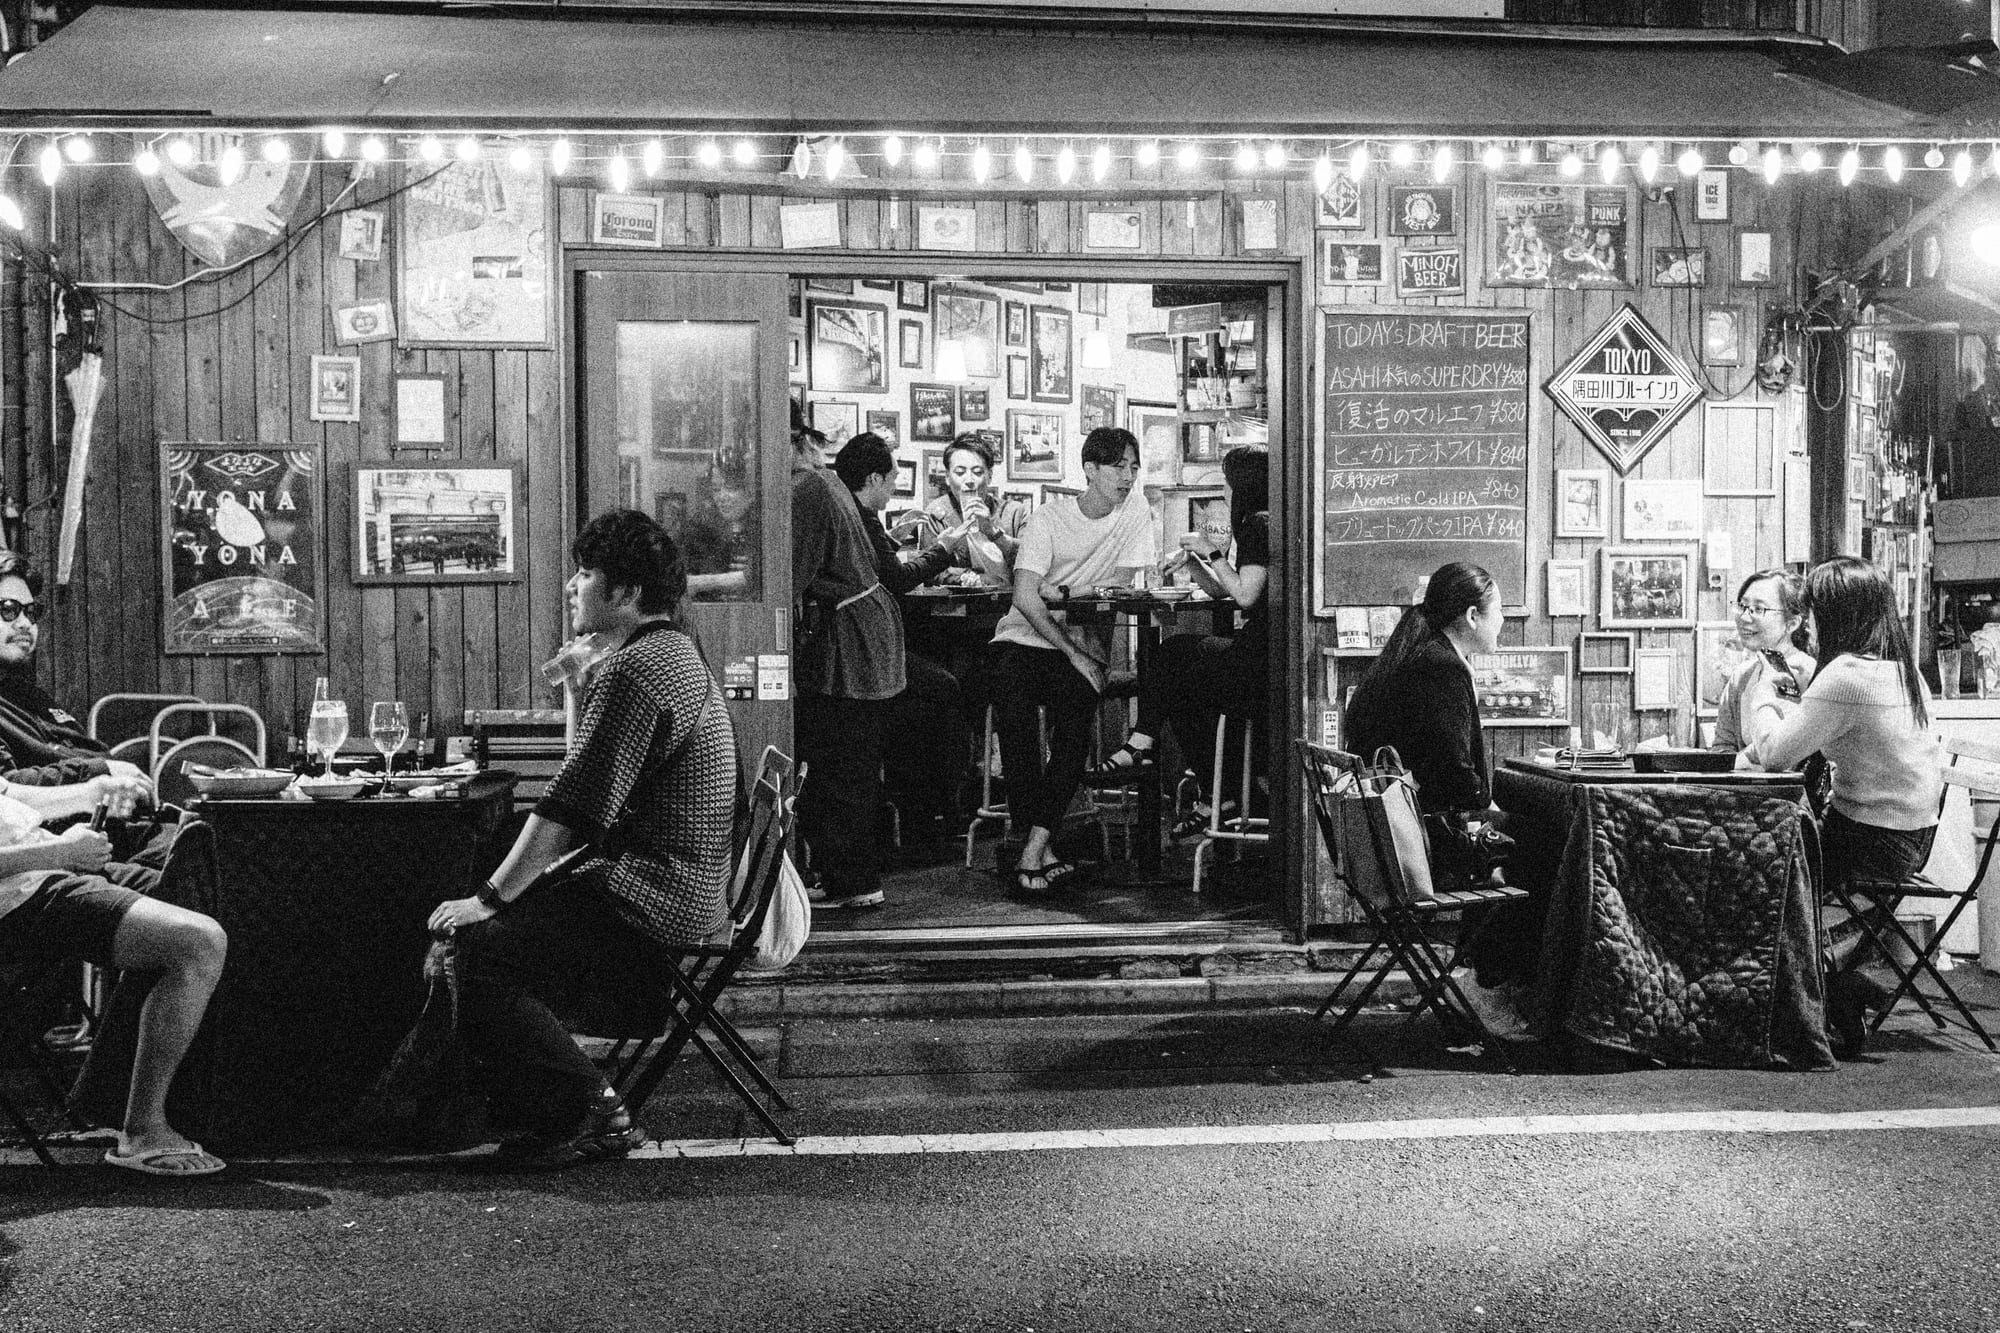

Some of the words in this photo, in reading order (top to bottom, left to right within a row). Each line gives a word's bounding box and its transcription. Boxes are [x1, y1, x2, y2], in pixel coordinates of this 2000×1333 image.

[1705, 184, 1719, 196] ICE
[602, 211, 654, 230] Corona
[1401, 214, 1426, 230] NEST
[1591, 206, 1621, 221] PUNK
[1414, 270, 1447, 287] BEER
[1407, 321, 1475, 348] DRAFT
[1475, 323, 1527, 350] BEER
[1603, 347, 1651, 375] TOKYO
[1572, 377, 1679, 400] 隅田川ブルーイング
[1337, 398, 1484, 431] 復活のマルエフ
[1489, 398, 1527, 425] ¥580
[1334, 440, 1489, 466] ヒューガルデンホワイト
[1489, 438, 1525, 466] ¥840
[187, 491, 297, 510] YONA
[1351, 492, 1411, 508] Aromatic
[1414, 490, 1449, 505] Cold
[1452, 491, 1478, 506] IPA
[1480, 476, 1519, 500] ¥840
[1486, 510, 1525, 537] ¥840
[188, 545, 297, 566] YONA
[193, 597, 297, 619] ALE
